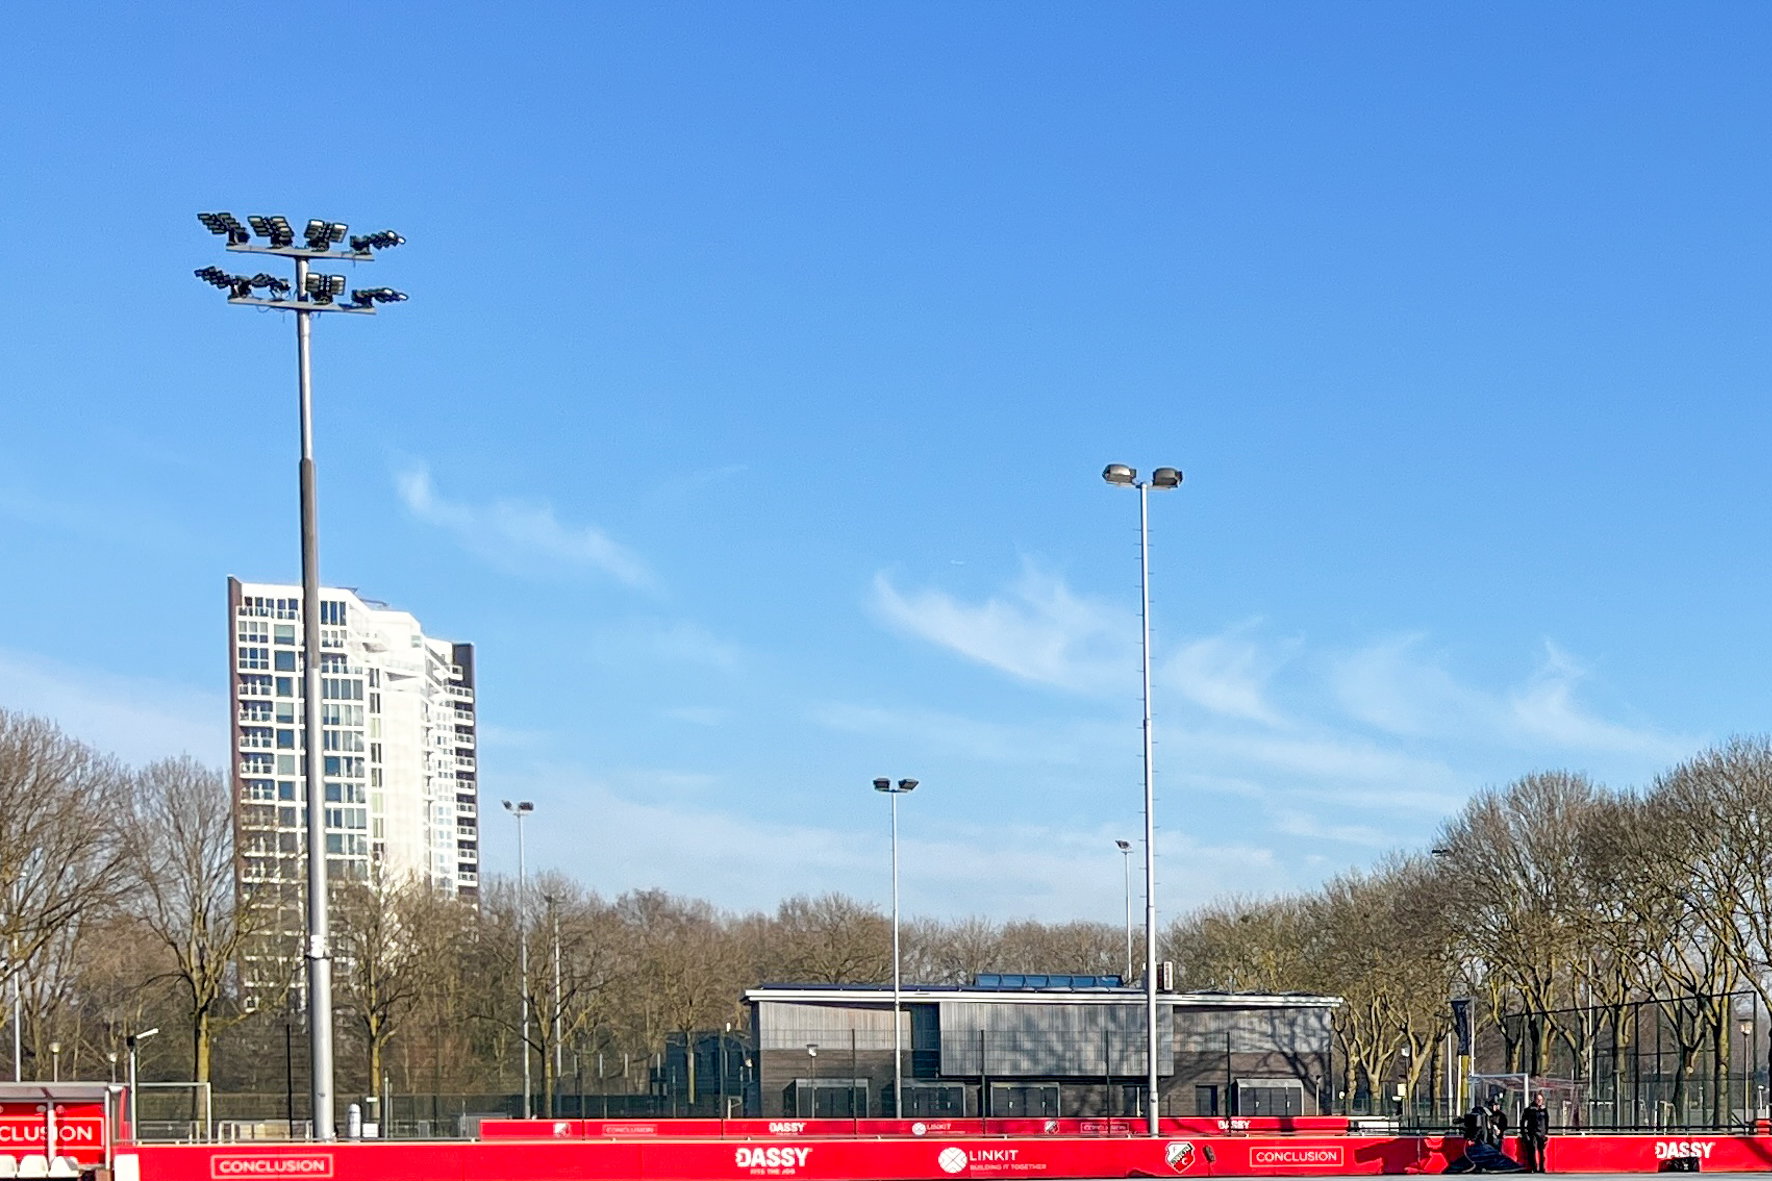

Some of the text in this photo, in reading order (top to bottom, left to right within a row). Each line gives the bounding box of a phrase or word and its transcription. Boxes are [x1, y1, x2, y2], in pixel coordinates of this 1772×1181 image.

[769, 1122, 806, 1132] DASSY
[1655, 1141, 1716, 1158] DASSY
[735, 1147, 812, 1167] DASSY
[969, 1150, 1018, 1161] LINKIT
[1256, 1151, 1337, 1162] CONCLUSION
[220, 1159, 325, 1173] CONCLUSION
[1011, 1163, 1046, 1171] TOGETHER
